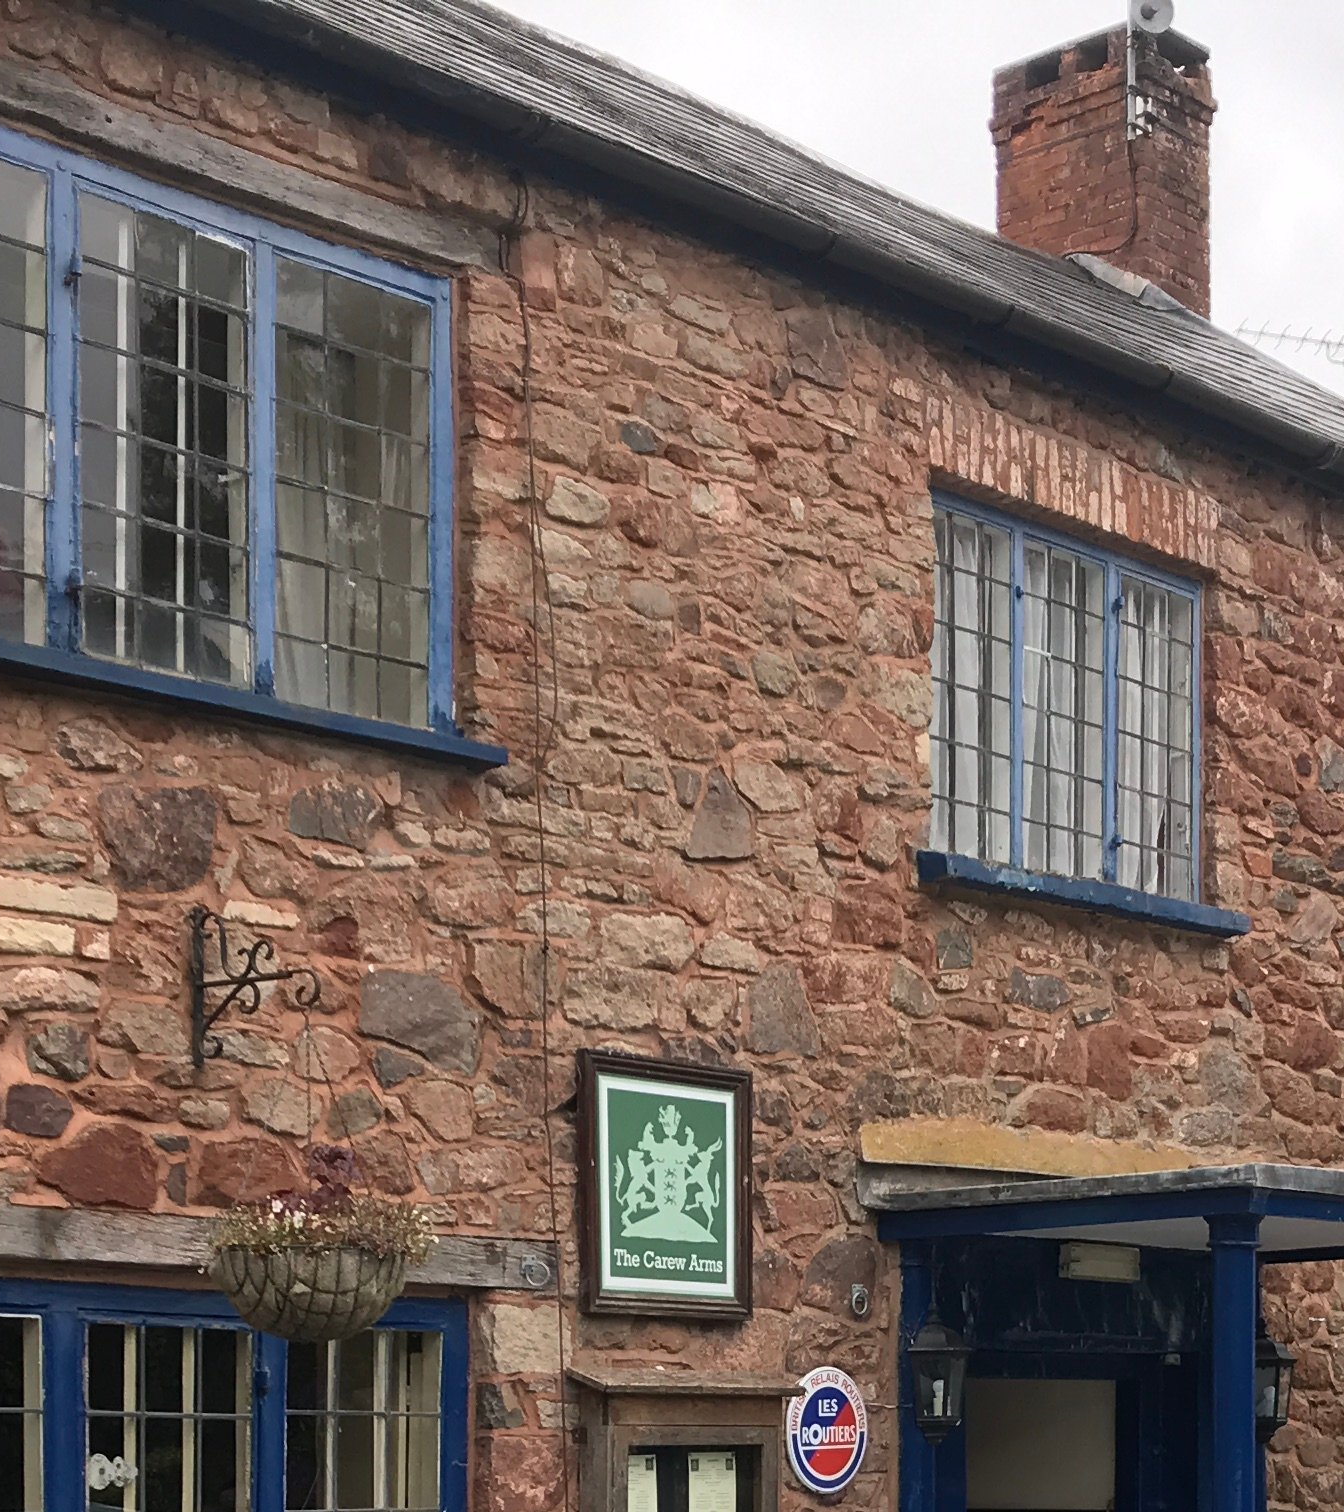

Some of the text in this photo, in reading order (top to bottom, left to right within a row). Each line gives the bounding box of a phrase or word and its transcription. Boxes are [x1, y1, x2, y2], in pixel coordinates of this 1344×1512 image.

[613, 1248, 724, 1273] The Carew Arms
[791, 1373, 866, 1431] BRITIS RELAIS ROUTIERS
[818, 1398, 838, 1417] LES
[801, 1423, 857, 1446] ROUTIERS
